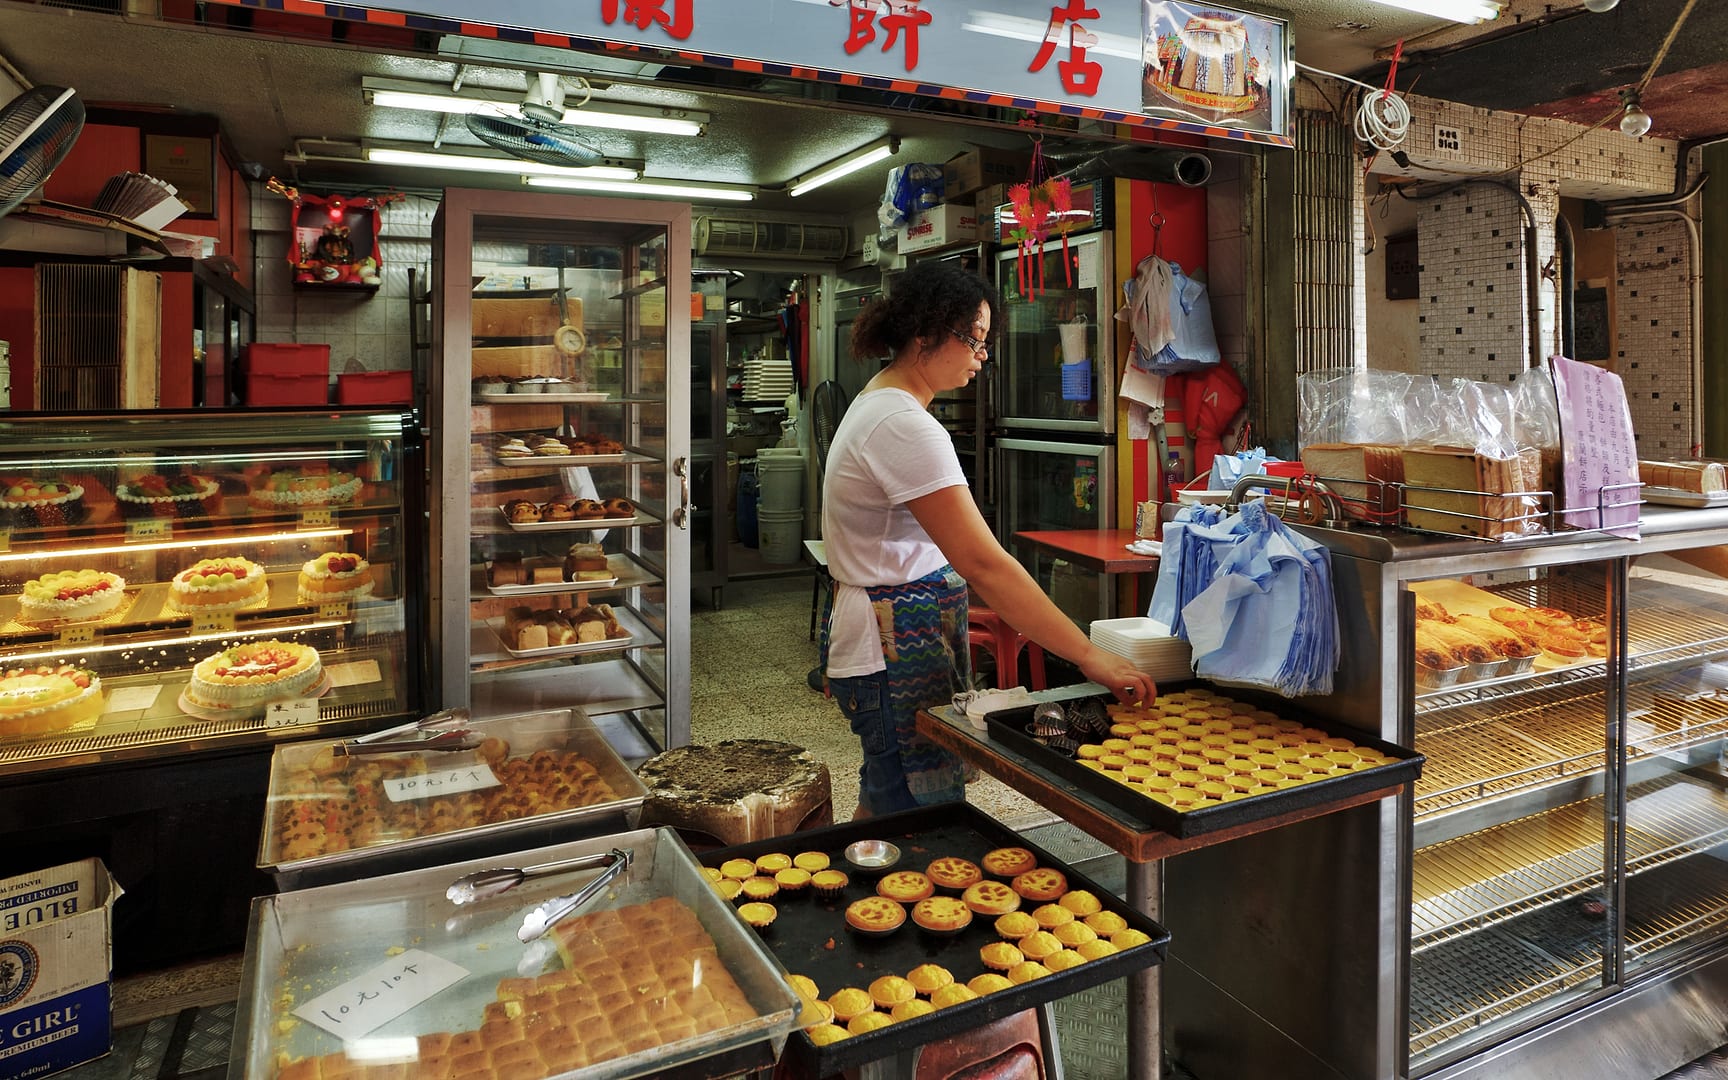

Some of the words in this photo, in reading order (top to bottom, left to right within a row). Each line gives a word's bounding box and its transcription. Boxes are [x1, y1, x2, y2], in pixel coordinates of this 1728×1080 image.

[8, 879, 41, 892] HANDLE
[16, 883, 77, 907] IMPORTED
[4, 897, 78, 931] BLUE
[12, 1007, 79, 1039] GIRL
[51, 1026, 77, 1041] BEER
